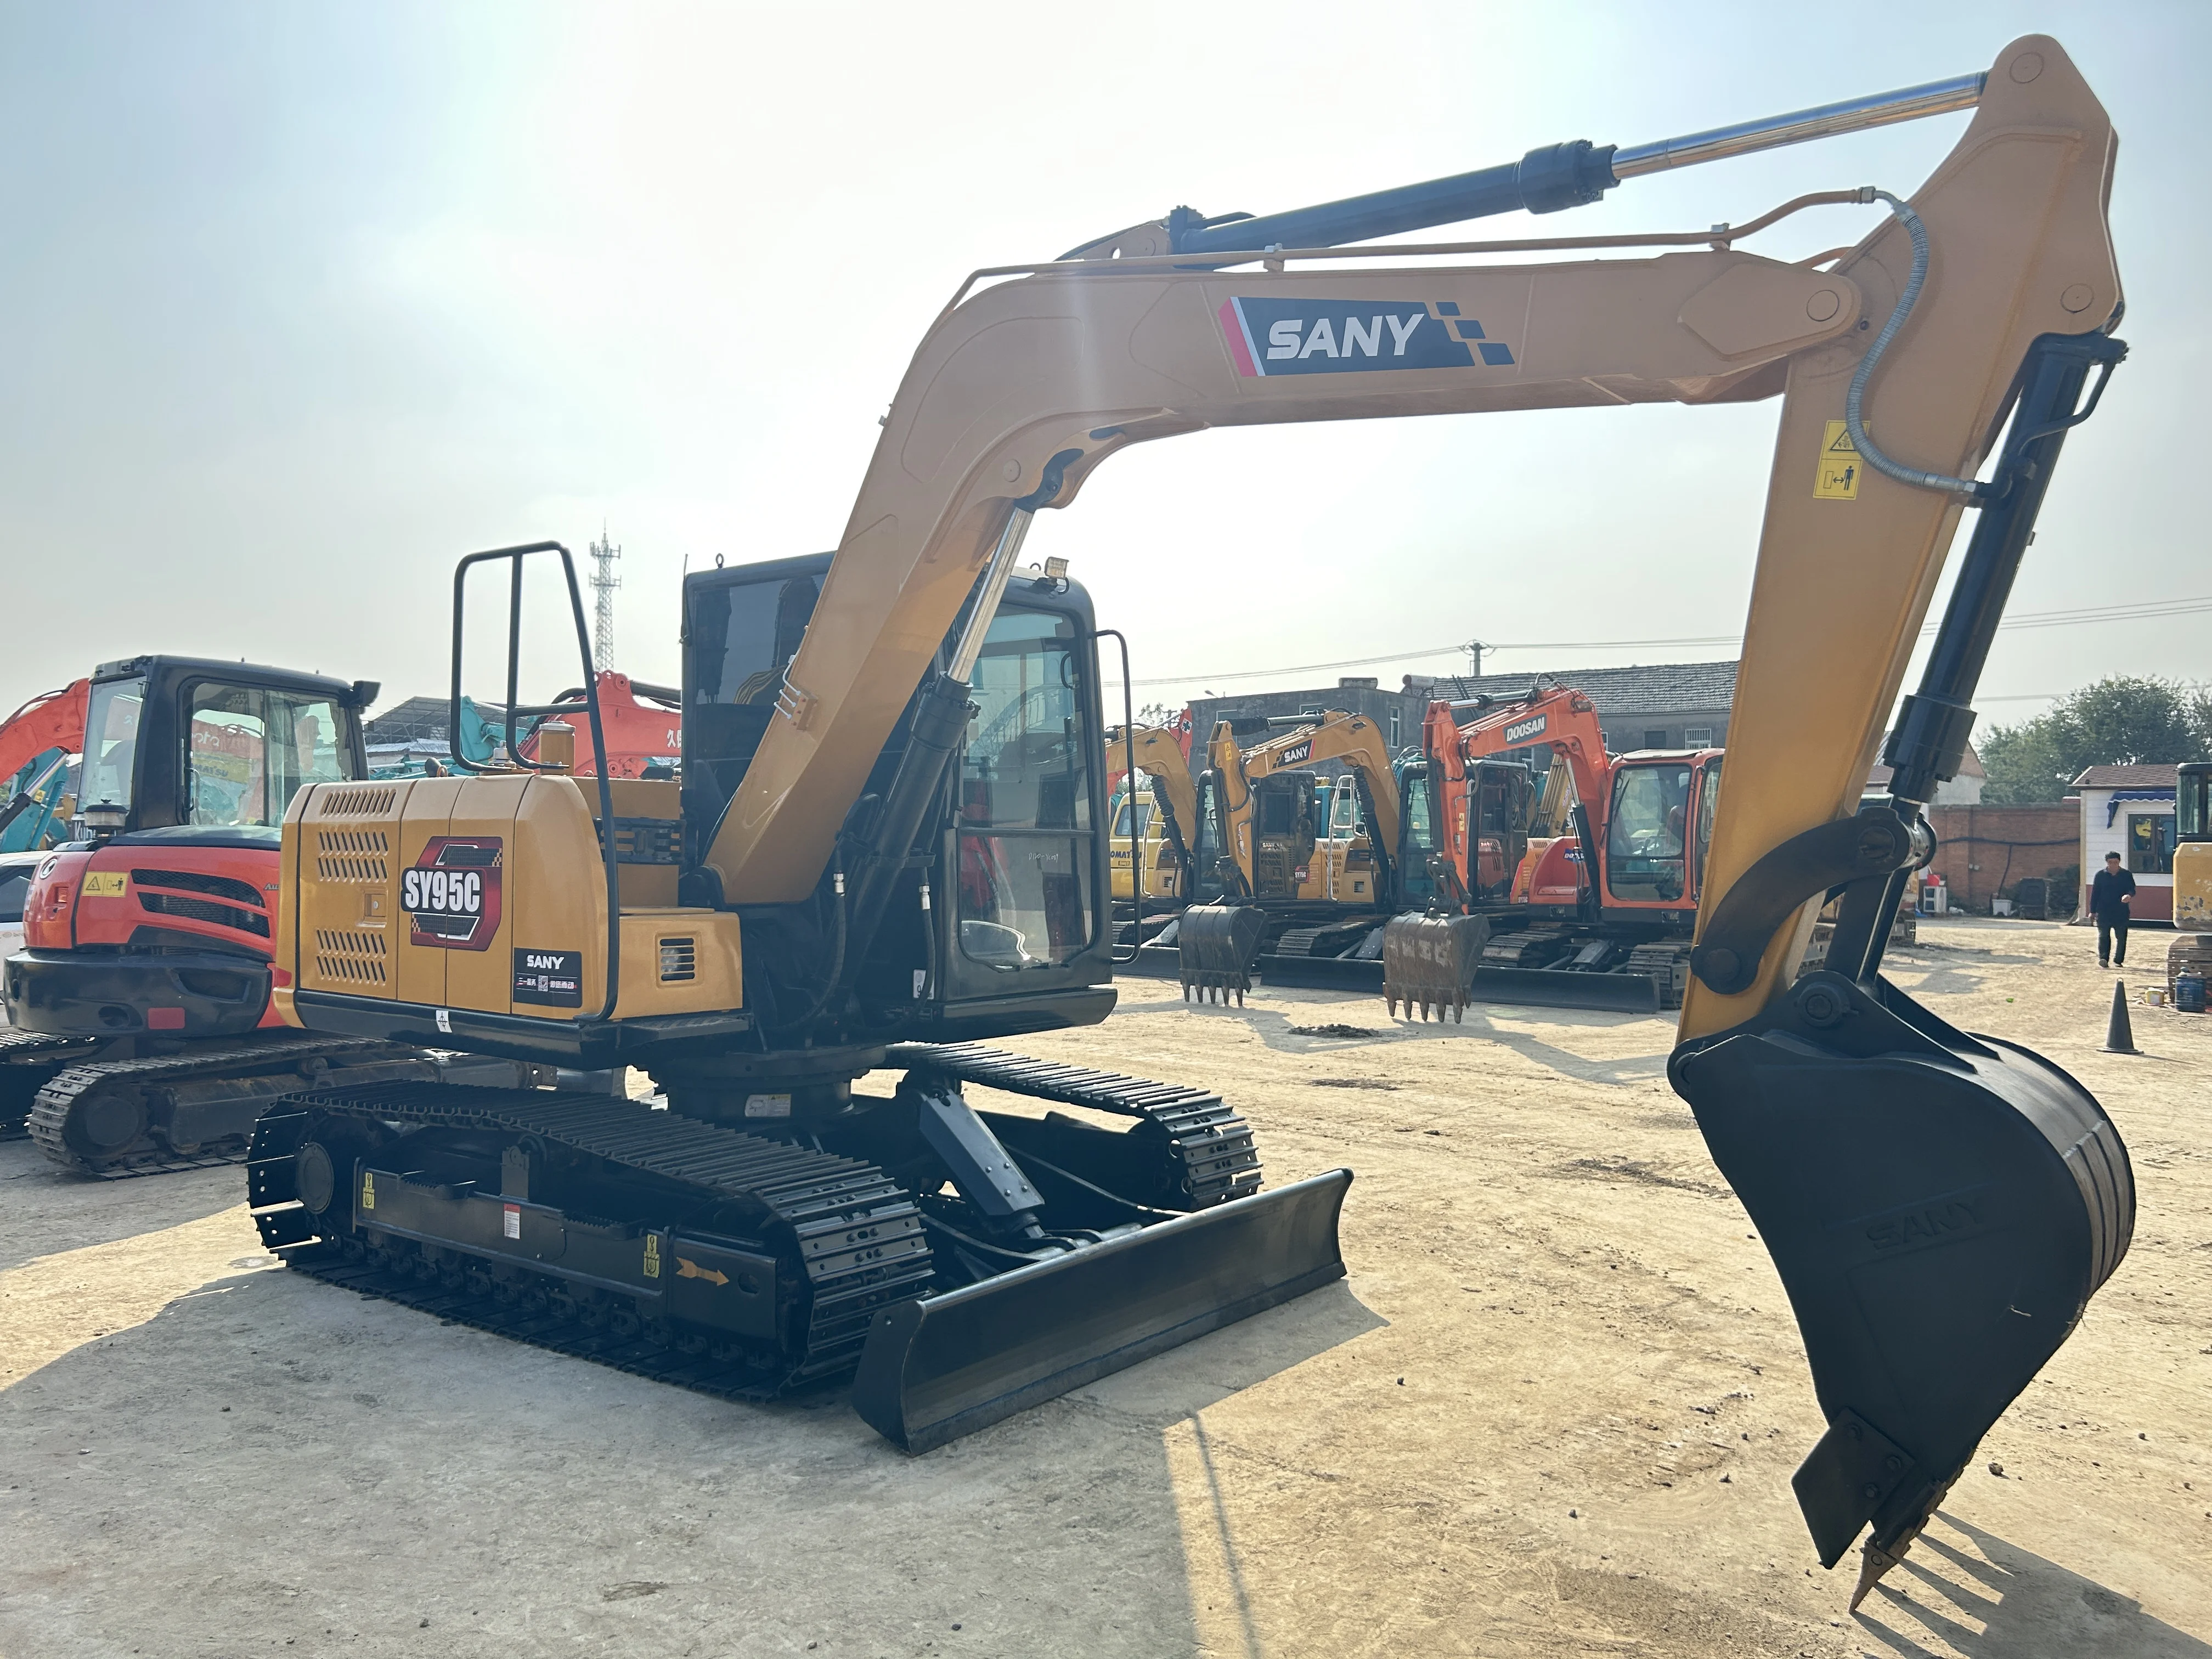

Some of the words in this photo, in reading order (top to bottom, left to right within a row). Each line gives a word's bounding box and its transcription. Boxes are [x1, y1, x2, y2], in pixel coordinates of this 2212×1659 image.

[1266, 313, 1425, 360] SANY
[1506, 716, 1544, 742] DOOSAN
[1284, 746, 1307, 763] SANY
[1110, 850, 1142, 859] OMATU
[405, 870, 480, 912] SY95C
[527, 955, 565, 969] SANY
[1866, 1197, 1984, 1250] SANY
